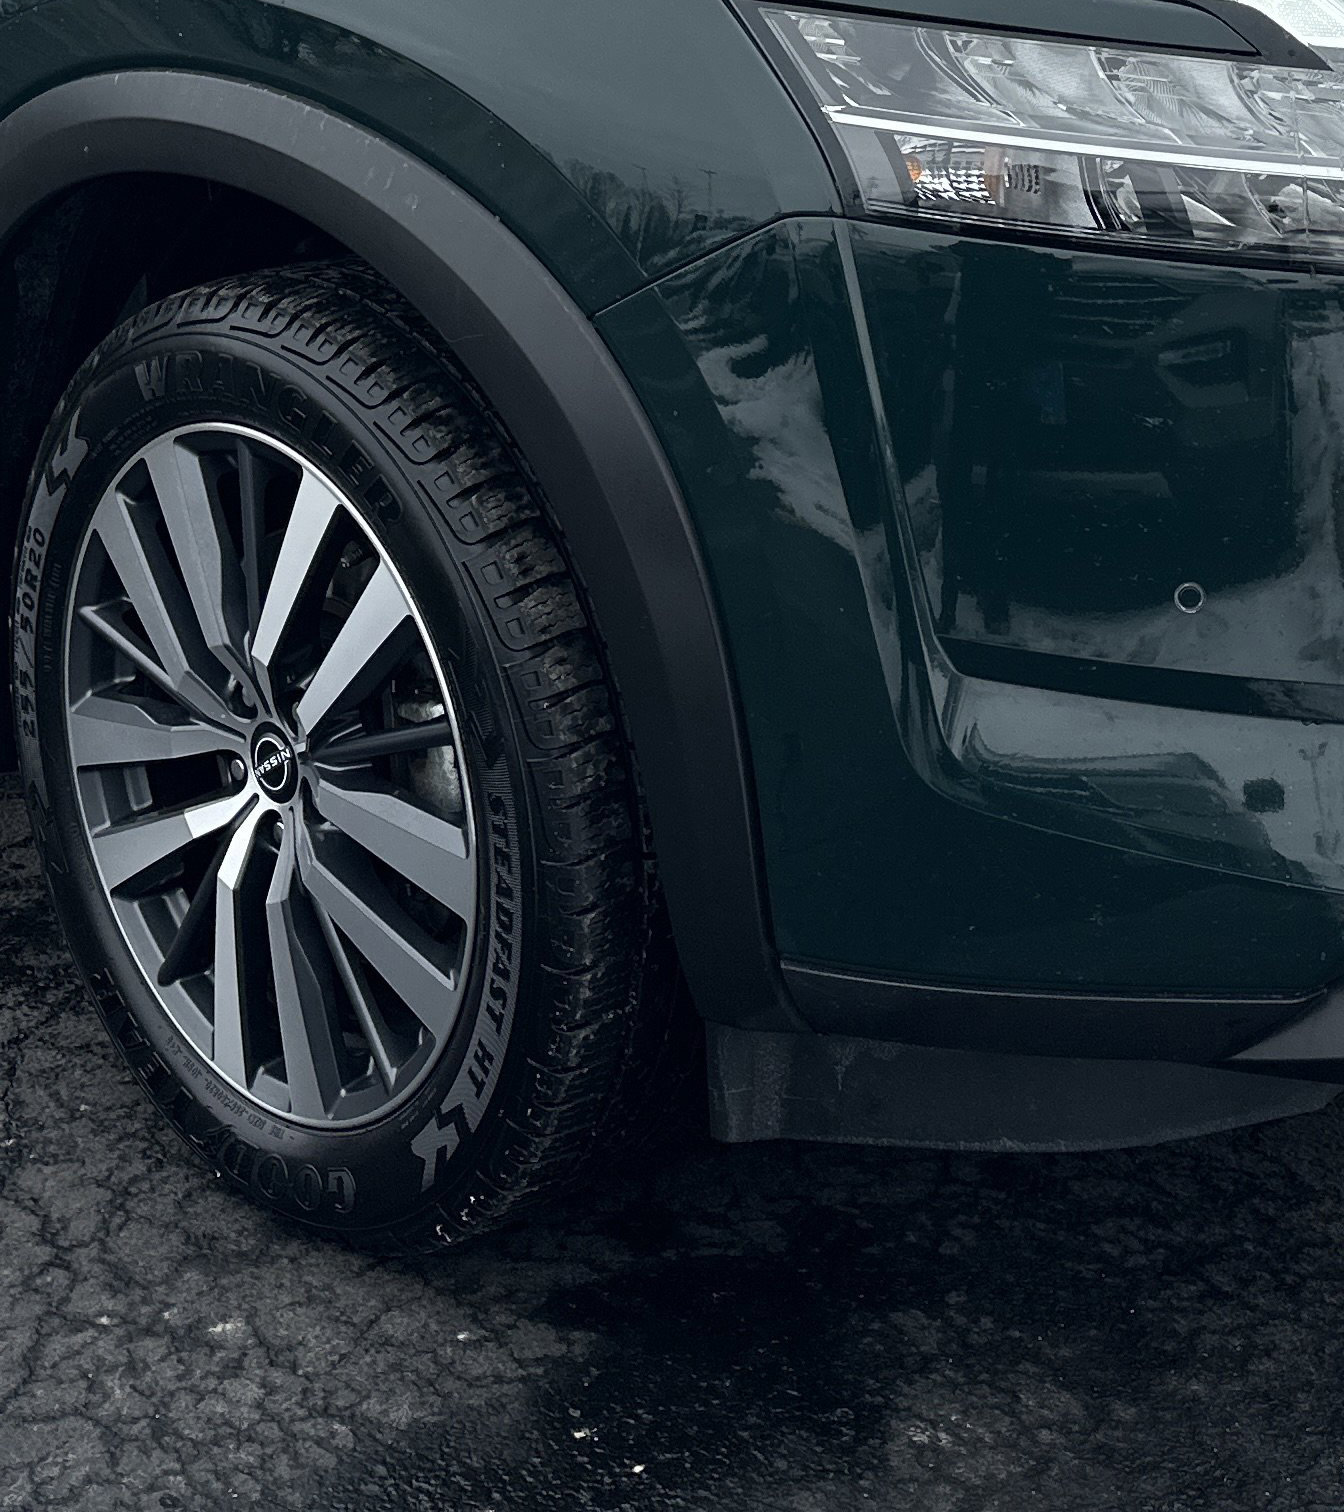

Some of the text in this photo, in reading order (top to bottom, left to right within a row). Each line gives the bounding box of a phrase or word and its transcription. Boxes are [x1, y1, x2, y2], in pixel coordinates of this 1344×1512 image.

[134, 350, 404, 534] WRANGLER
[18, 525, 47, 739] 255/50R20
[255, 748, 291, 778] NISSAN
[467, 793, 515, 1101] STEADFAST HT
